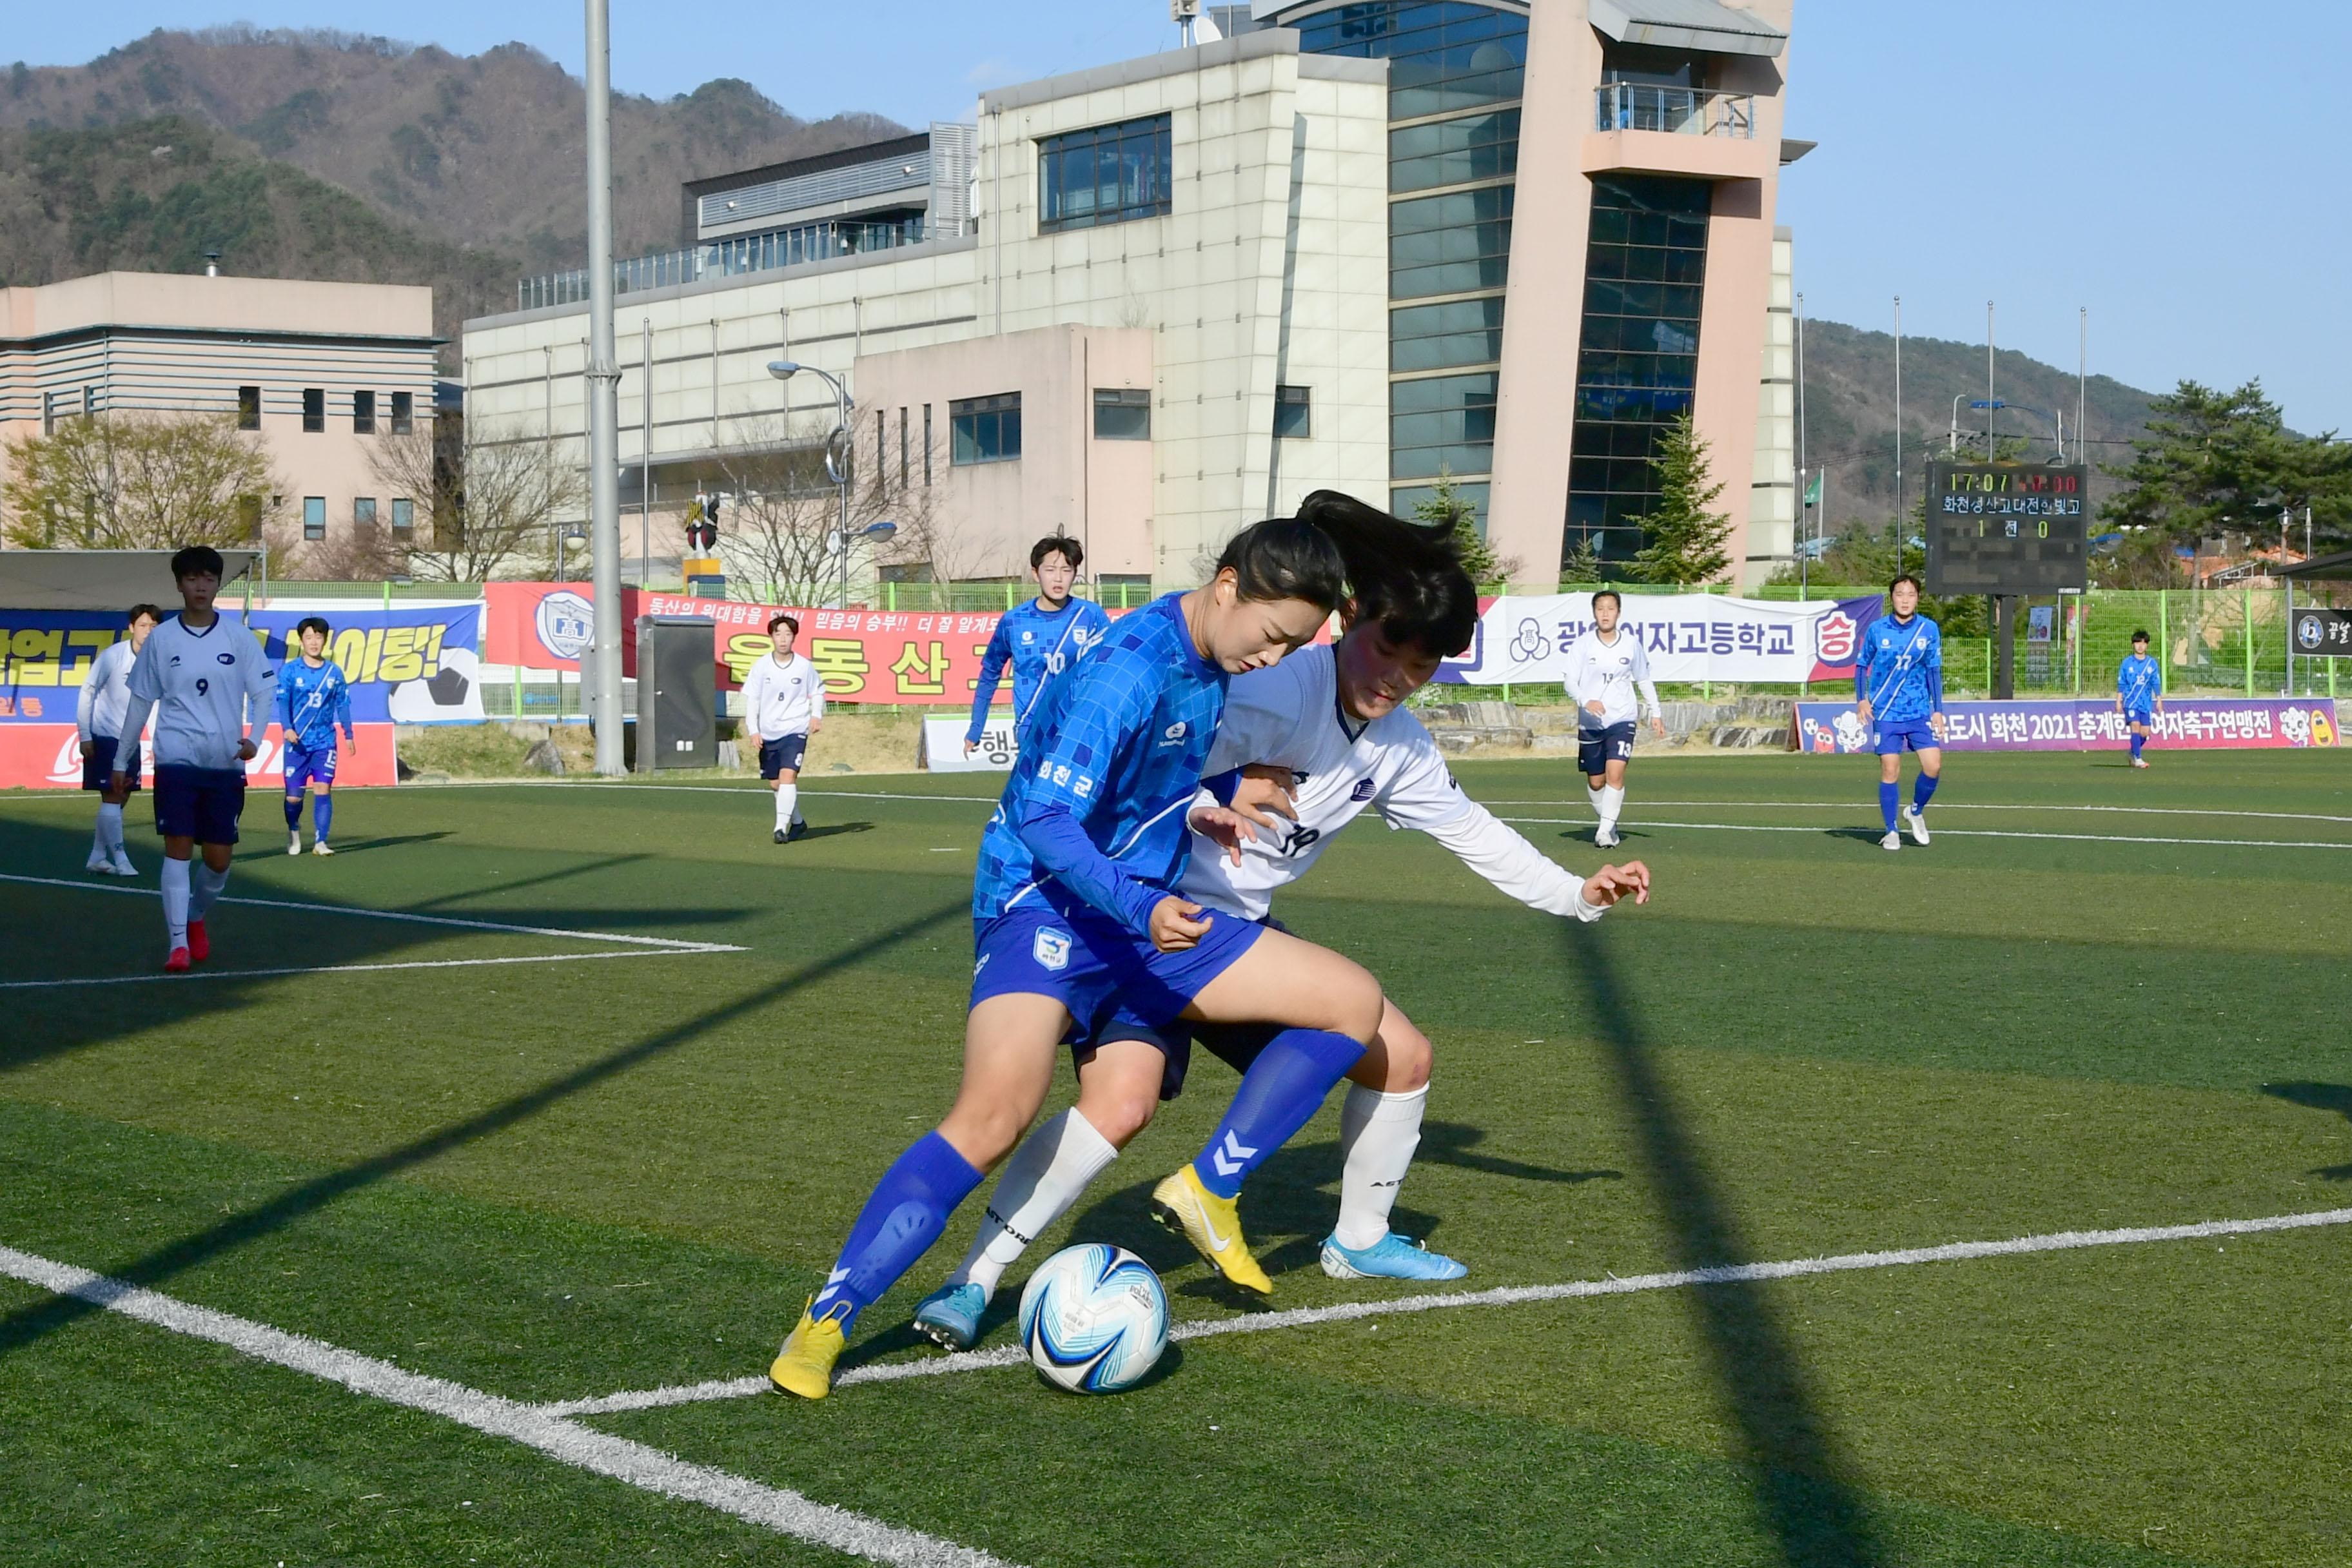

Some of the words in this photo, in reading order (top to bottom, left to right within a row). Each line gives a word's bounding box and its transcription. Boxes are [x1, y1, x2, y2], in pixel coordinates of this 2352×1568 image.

[1951, 474, 2007, 492] 17:07
[1978, 520, 1984, 537] 1
[2039, 521, 2048, 538] 0
[650, 598, 695, 616] 동산의
[815, 612, 861, 631] 믿음의
[867, 616, 908, 632] 승부!!
[917, 619, 932, 632] 더
[938, 616, 953, 633] 잘
[1558, 620, 1795, 656] 광여자고등학교
[1043, 652, 1065, 675] 10
[1602, 672, 1613, 684] 13
[196, 679, 208, 696] 9
[308, 692, 322, 708] 13
[778, 692, 785, 701] 8
[1989, 713, 2028, 742] 화천
[2030, 715, 2077, 740] 2021
[2078, 710, 2272, 740] 춘계한여자축구연맹전
[1617, 741, 1631, 757] 13
[794, 752, 803, 767] 8
[1037, 760, 1094, 798] 화천군
